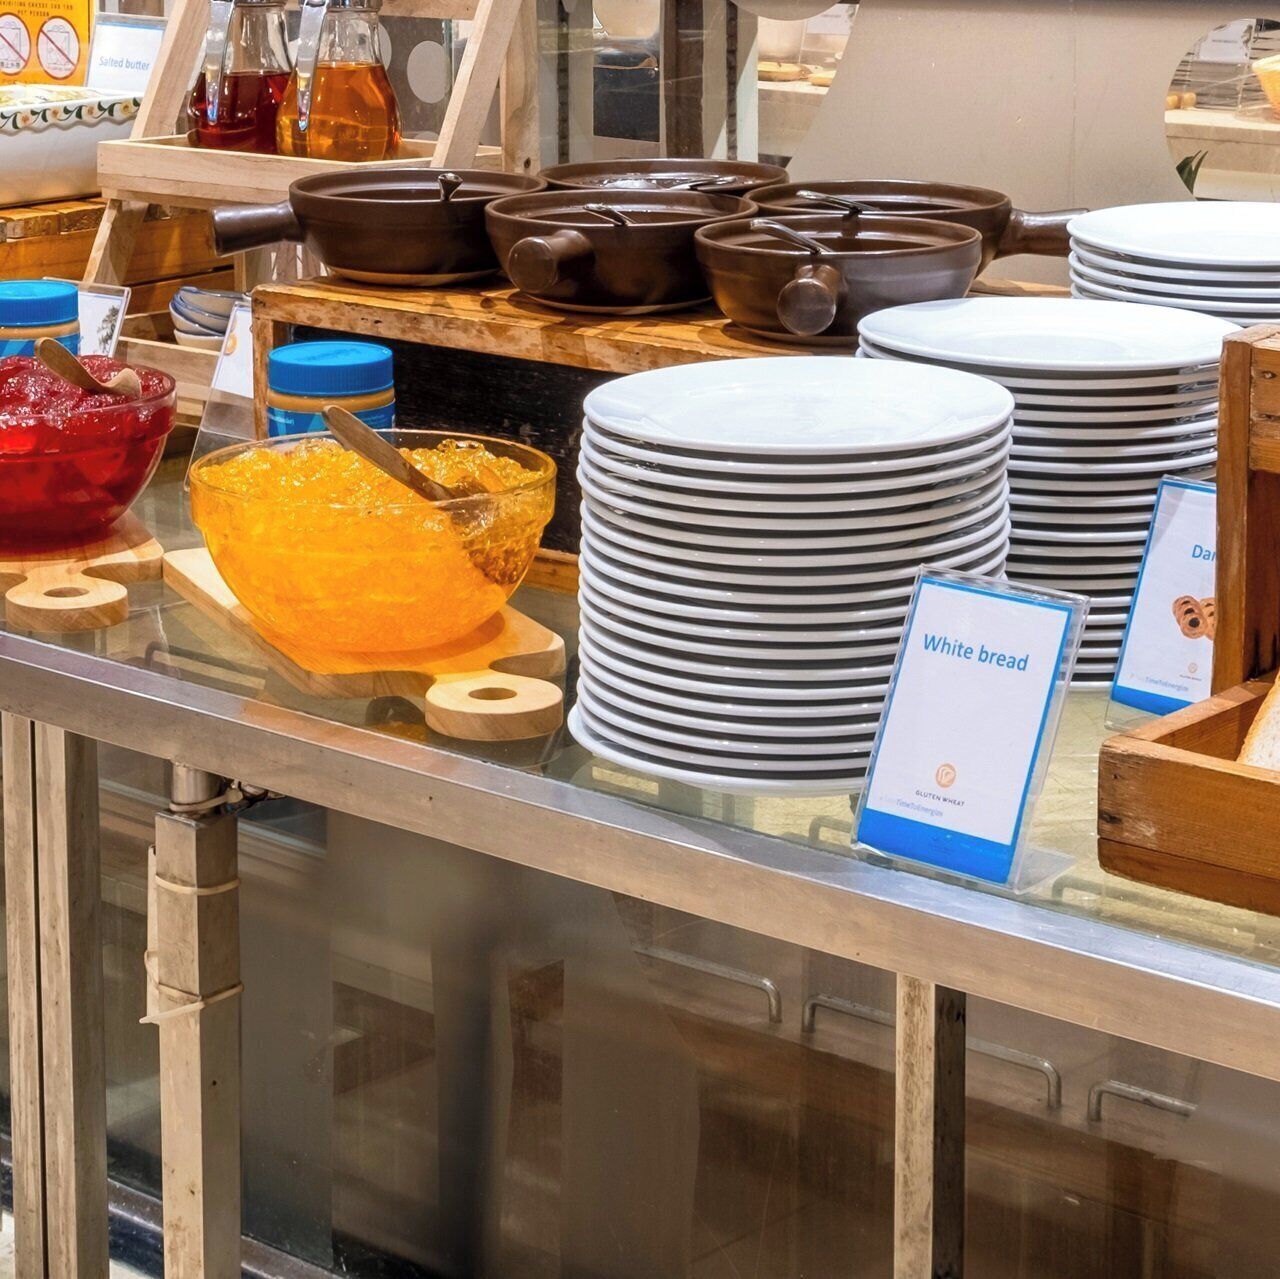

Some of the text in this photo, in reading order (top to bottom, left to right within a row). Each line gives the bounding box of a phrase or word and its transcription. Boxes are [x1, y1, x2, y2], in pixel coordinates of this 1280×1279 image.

[99, 55, 150, 71] Salted butter
[923, 633, 1030, 672] White bread
[915, 789, 965, 807] GLUTEN WHEAT
